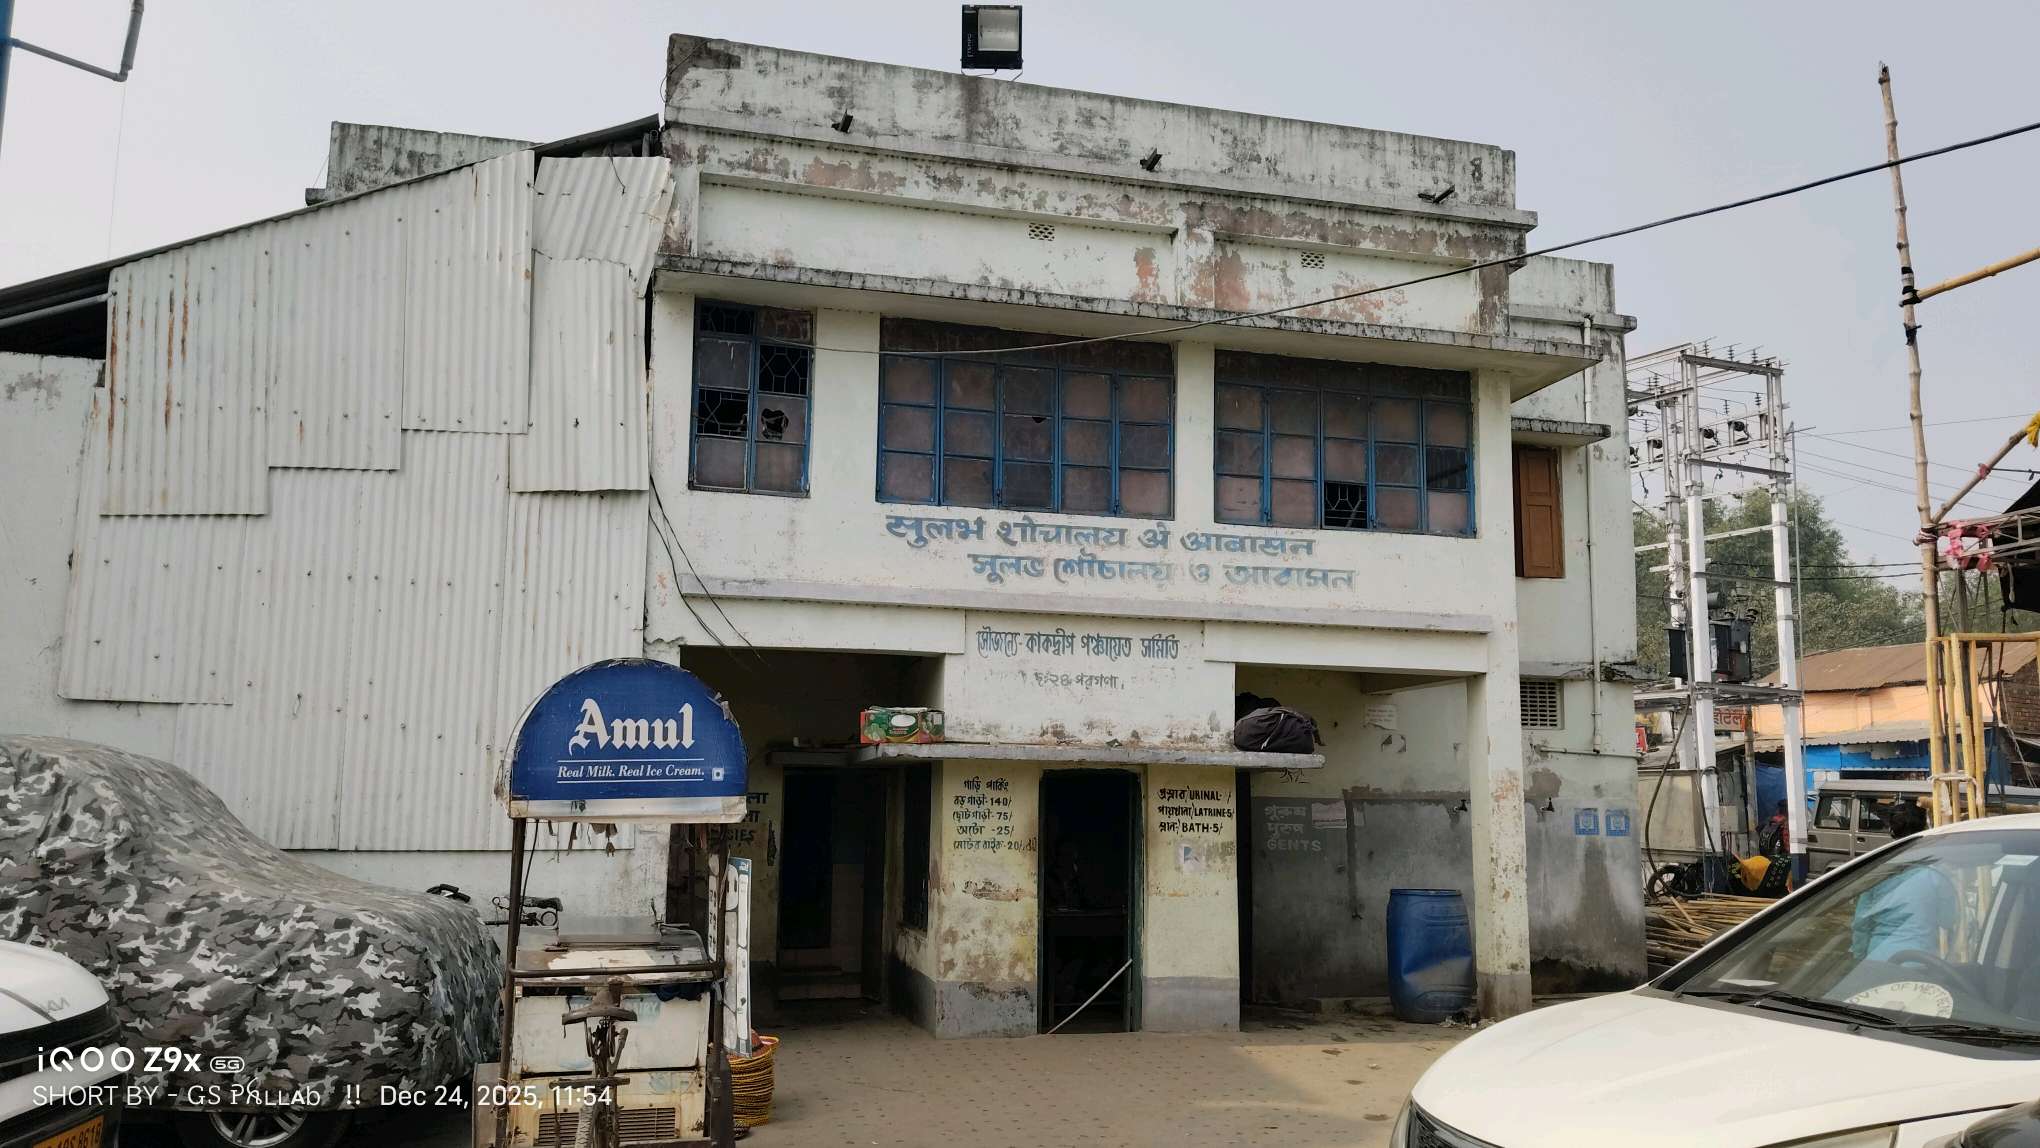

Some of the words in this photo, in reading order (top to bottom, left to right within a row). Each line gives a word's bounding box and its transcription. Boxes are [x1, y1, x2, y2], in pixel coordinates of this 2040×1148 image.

[886, 515, 986, 548] सुलभ
[568, 698, 696, 757] Amul
[557, 765, 584, 778] Real
[586, 765, 615, 777] Milk.
[618, 765, 645, 777] Real
[645, 764, 663, 776] Ice
[665, 764, 705, 776] Cream.
[1267, 839, 1321, 852] GENTS
